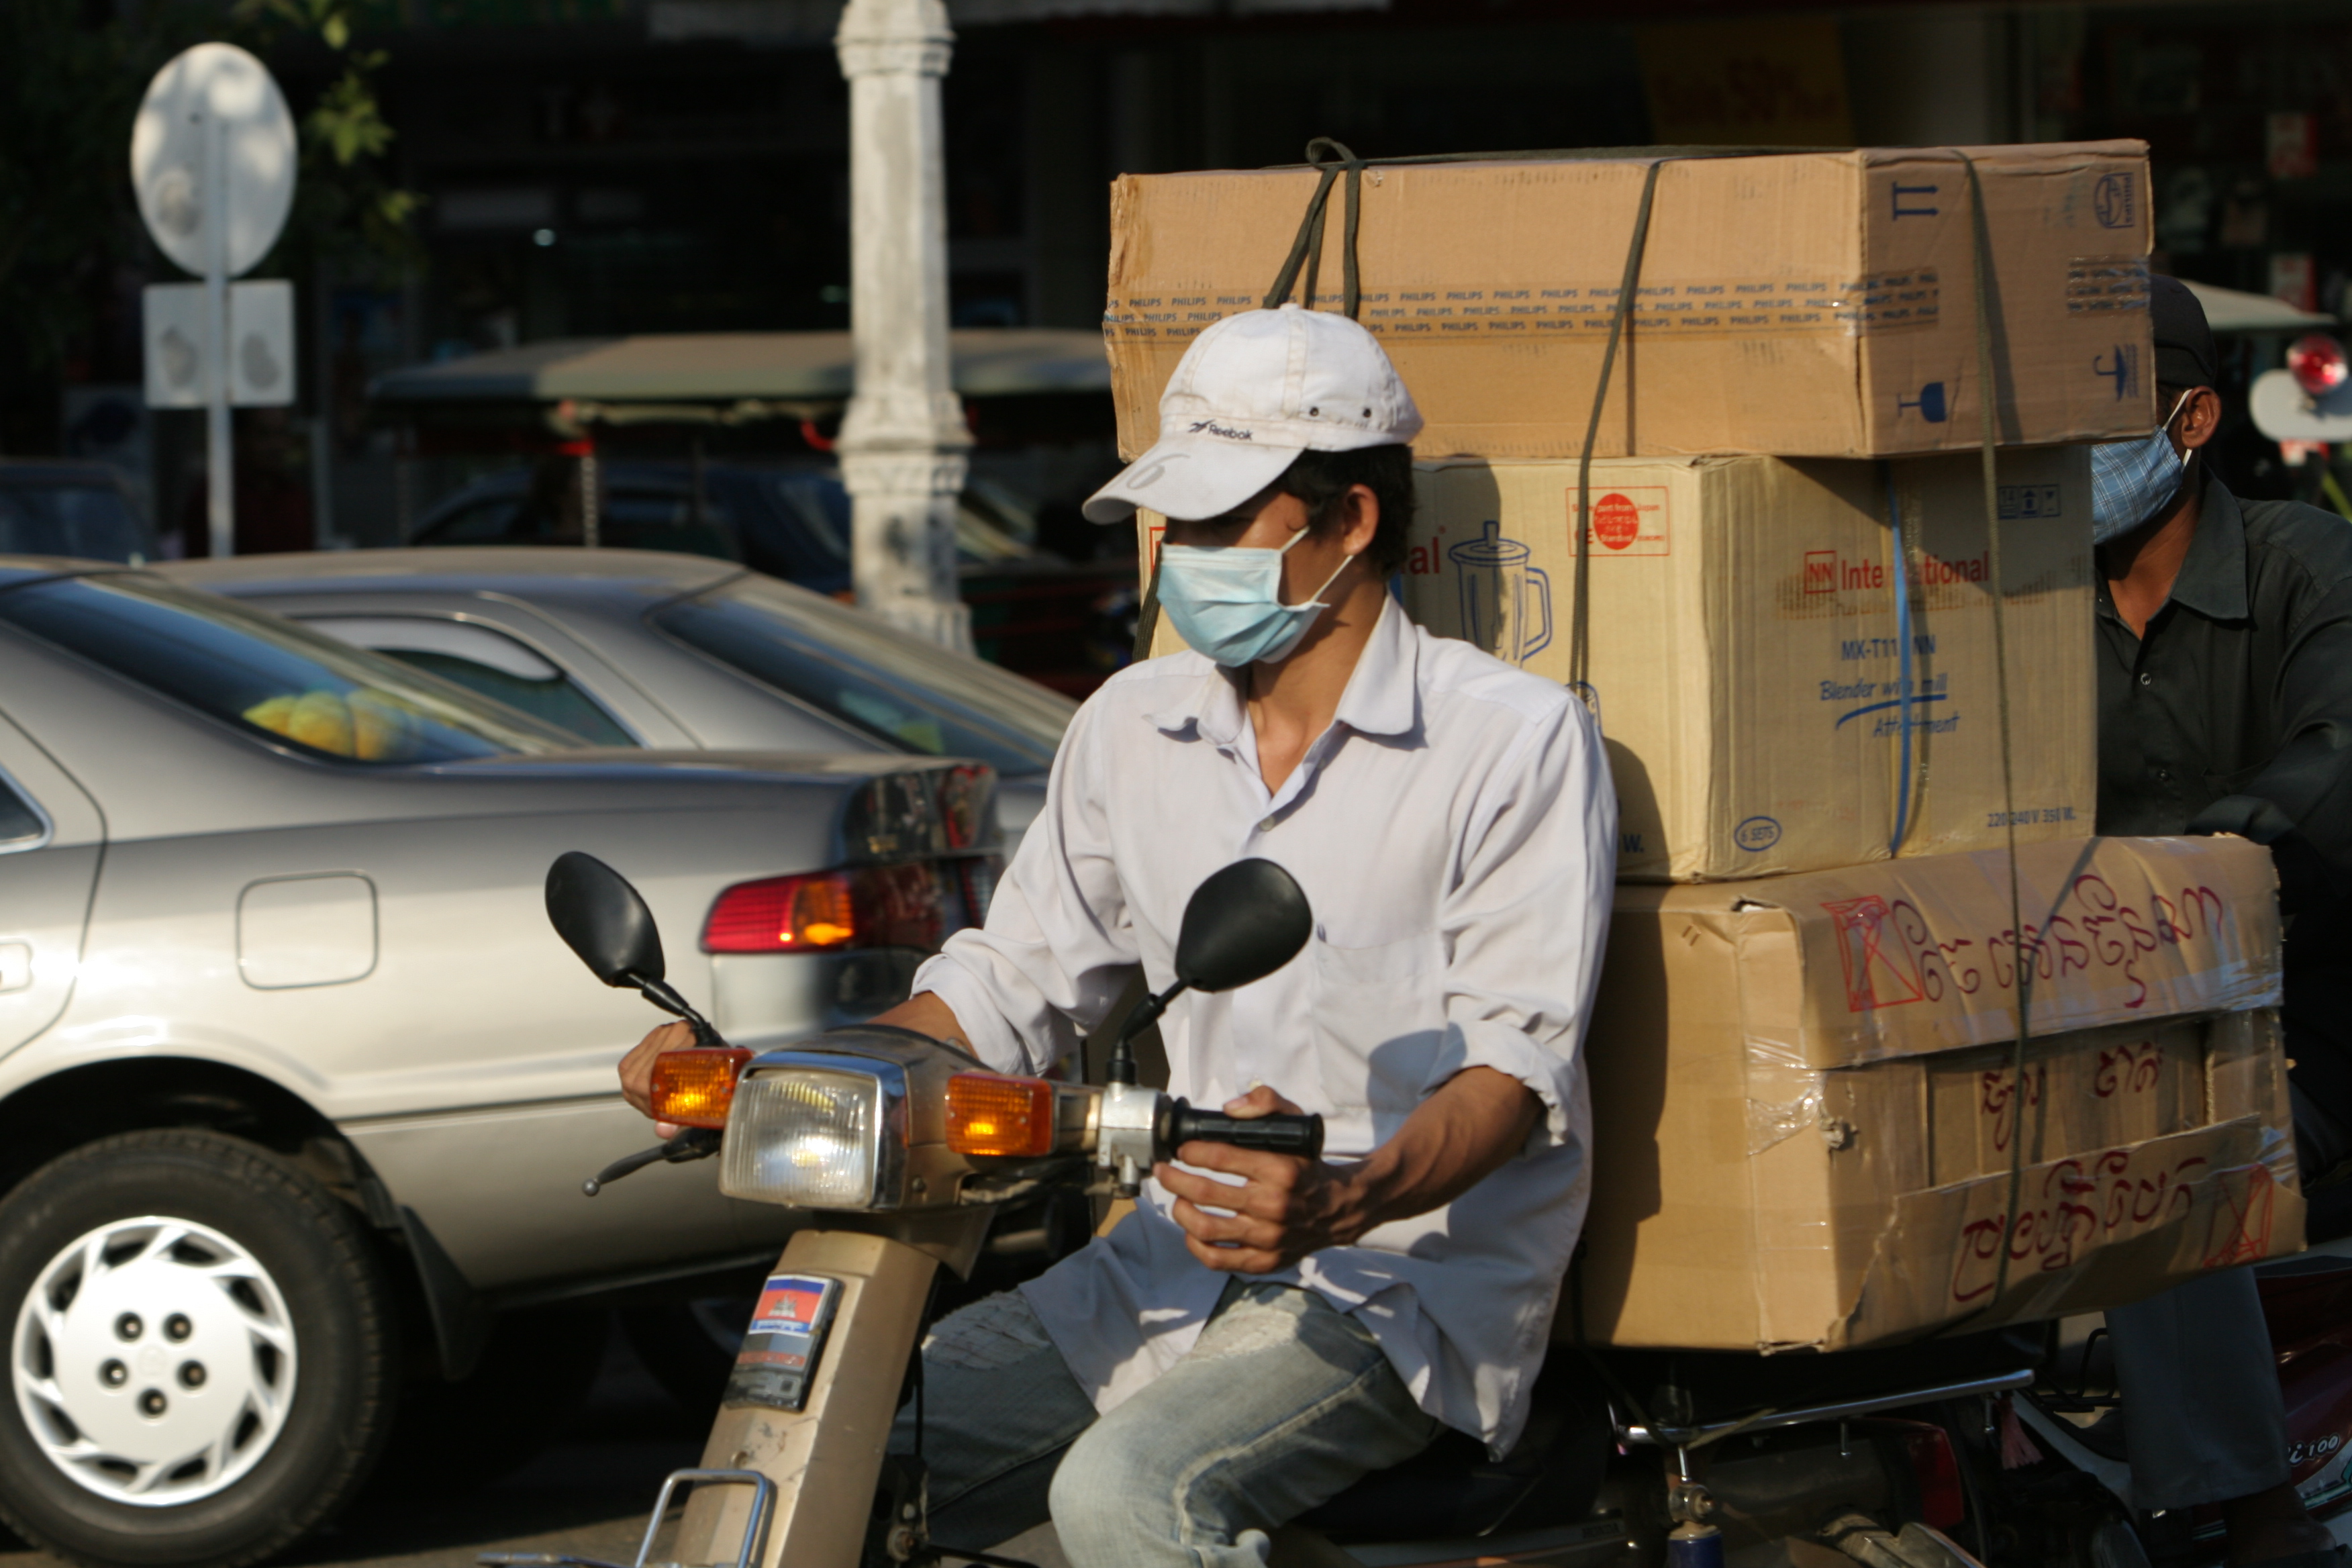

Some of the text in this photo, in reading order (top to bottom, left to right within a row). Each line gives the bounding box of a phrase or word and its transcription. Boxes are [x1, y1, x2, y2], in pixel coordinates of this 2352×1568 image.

[1129, 297, 1162, 307] PHILIPS
[1171, 296, 1207, 306] PHILIPS
[1216, 295, 1252, 305] PHILIPS
[1400, 292, 1436, 301] PHILIPS
[1447, 291, 1483, 300] PHILIPS
[1493, 290, 1530, 299] PHILIPS
[1540, 289, 1578, 298] PHILIPS
[1686, 285, 1724, 295] PHILIPS
[1735, 283, 1774, 293] PHILIPS
[1786, 282, 1827, 292] PHILIPS
[1144, 313, 1177, 322] PHILIPS
[1187, 312, 1222, 322] PHILIPS
[1370, 308, 1406, 317] PHILIPS
[1416, 307, 1453, 316] PHILIPS
[1463, 306, 1500, 315] PHILIPS
[1511, 305, 1547, 314] PHILIPS
[1558, 304, 1596, 313] PHILIPS
[1655, 302, 1693, 311] PHILIPS
[1704, 300, 1743, 309] PHILIPS
[1753, 299, 1793, 309] PHILIPS
[1126, 328, 1157, 337] PHILIPS
[1166, 327, 1201, 336] PHILIPS
[1394, 323, 1432, 332] PHILIPS
[1441, 322, 1479, 332] PHILIPS
[1488, 321, 1526, 330] PHILIPS
[1536, 320, 1573, 330] PHILIPS
[1681, 317, 1720, 326] PHILIPS
[1729, 315, 1769, 325] PHILIPS
[1780, 313, 1821, 324] PHILIPS
[1208, 424, 1253, 442] Reebok
[1820, 677, 1877, 701] Blender
[2308, 1435, 2339, 1457] 100
